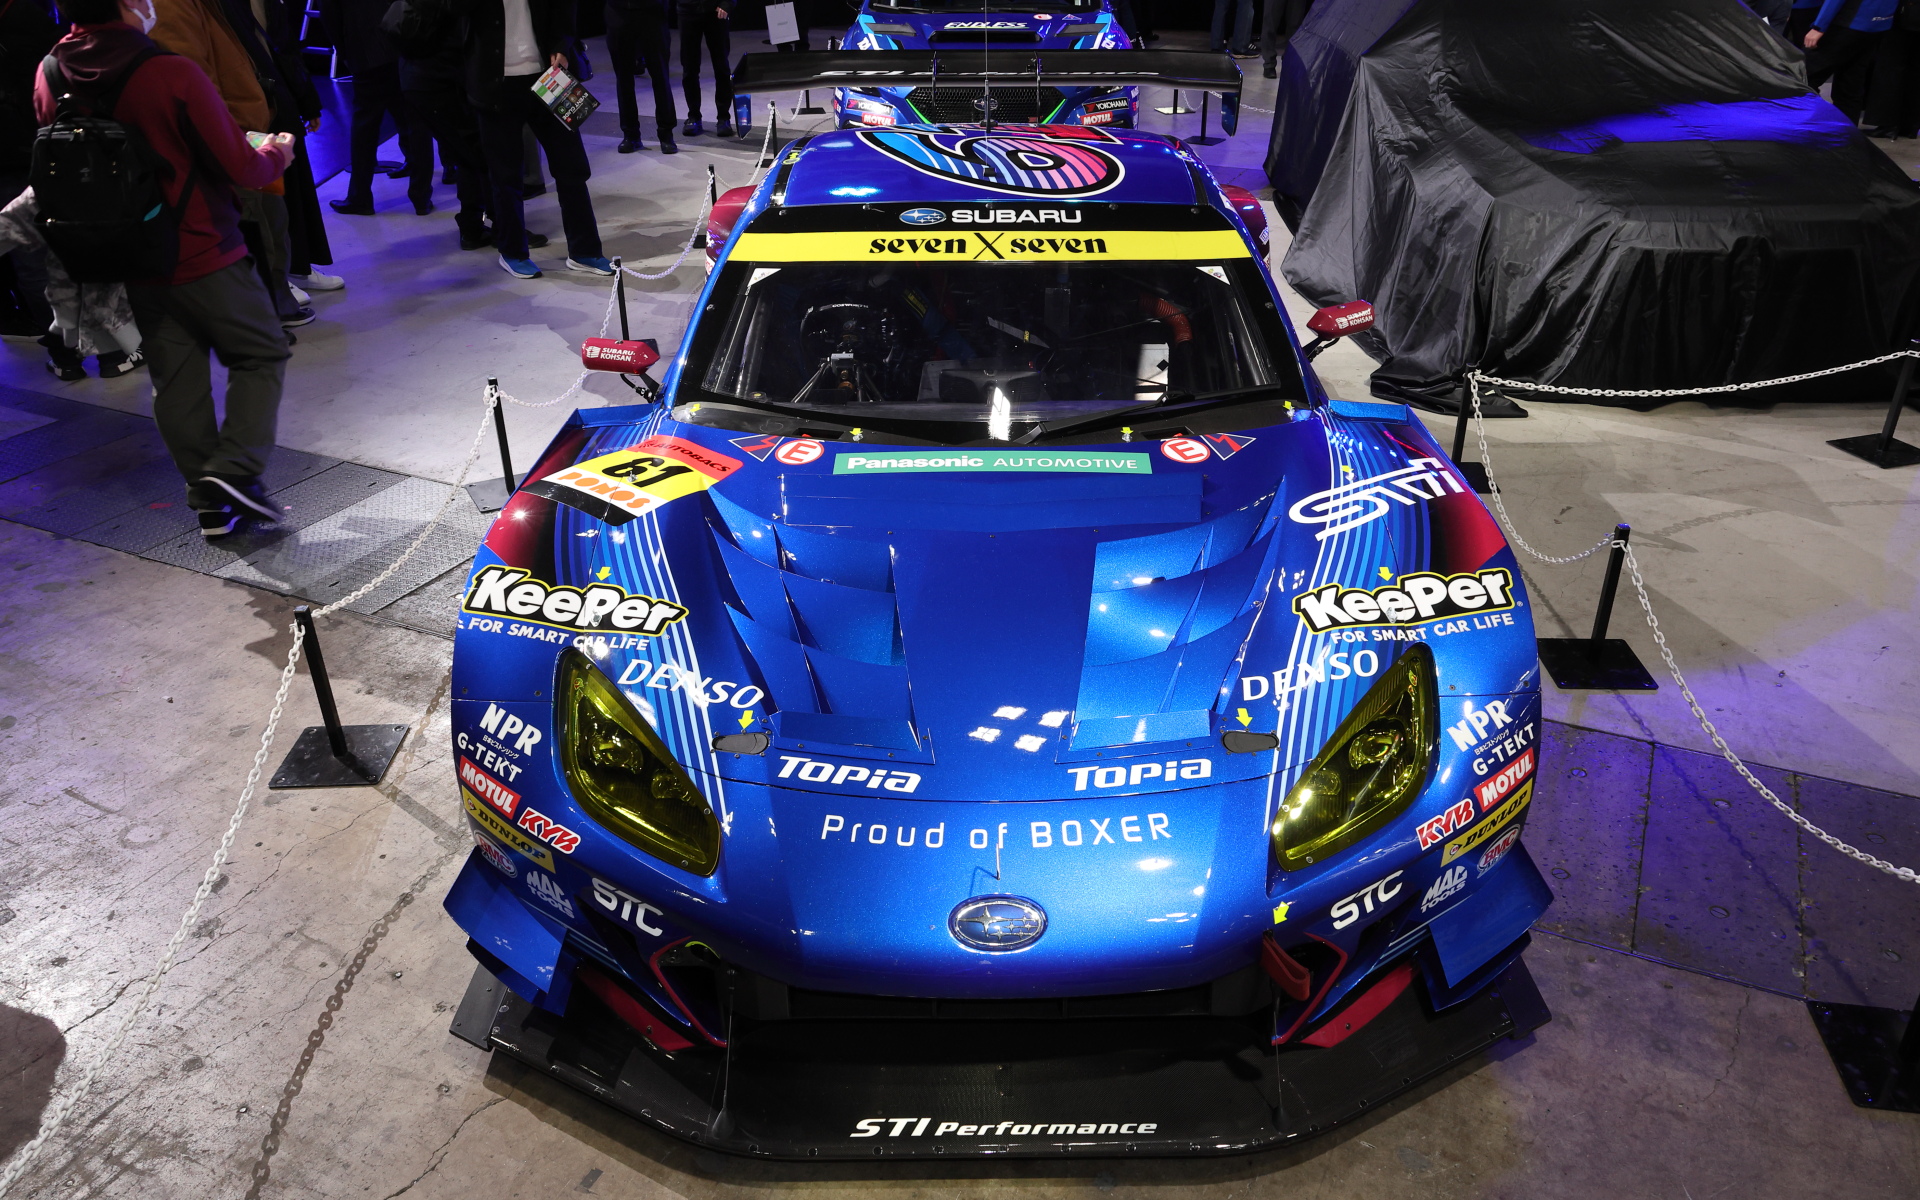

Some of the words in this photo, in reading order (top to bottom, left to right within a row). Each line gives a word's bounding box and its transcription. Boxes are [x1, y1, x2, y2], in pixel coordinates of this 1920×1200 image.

[863, 114, 892, 126] MOTUL
[1083, 113, 1112, 125] MOTUL
[1096, 99, 1128, 110] YOKOHAMA
[951, 209, 1082, 223] SUBARU
[869, 238, 967, 254] seven
[1010, 237, 1109, 254] seven
[1349, 314, 1373, 326] KOHSAN
[600, 352, 632, 362] KOHSAN
[601, 347, 634, 356] SUBARU
[601, 457, 694, 488] 61
[655, 442, 731, 472] AUTOBACS
[847, 455, 984, 469] Panasonic
[993, 457, 1138, 469] AUTOMOTIVE
[556, 471, 650, 509] PONOS
[469, 568, 683, 632] KeePer
[1299, 571, 1508, 629] KeePer
[467, 617, 502, 633] FOR
[507, 623, 569, 645] SMART
[609, 636, 650, 651] LIFE
[1330, 630, 1369, 645] FOR
[1371, 627, 1427, 642] SMART
[1433, 620, 1470, 637] CAR
[1475, 612, 1515, 630] LIFE
[617, 658, 765, 709] DENSO
[1240, 649, 1379, 702] DENSO
[479, 702, 542, 757] NPR
[1447, 700, 1513, 752] NPR
[1474, 728, 1509, 756] 日本ピストンリング
[457, 732, 523, 783] G-TEKT
[482, 734, 520, 759] 日本ピストンリング
[1472, 722, 1535, 776] G-TEKT
[461, 762, 515, 814] MOTUL
[1480, 754, 1533, 807] MOTUL
[478, 808, 546, 859] DUNLOP
[518, 808, 580, 853] KYB
[820, 814, 945, 849] Proud
[969, 821, 1009, 849] of
[1030, 812, 1173, 848] BOXER
[1416, 799, 1474, 850] KYB
[1463, 790, 1528, 848] DUNLOP
[479, 837, 512, 870] BMC
[1482, 829, 1517, 866] BMC
[526, 871, 573, 910] MAC
[527, 884, 575, 919] TOOLS
[591, 877, 664, 937] STC
[1330, 869, 1404, 930] STC
[1420, 880, 1466, 913] TOOLS
[850, 1117, 932, 1138] STI
[934, 1121, 1158, 1137] Performance
